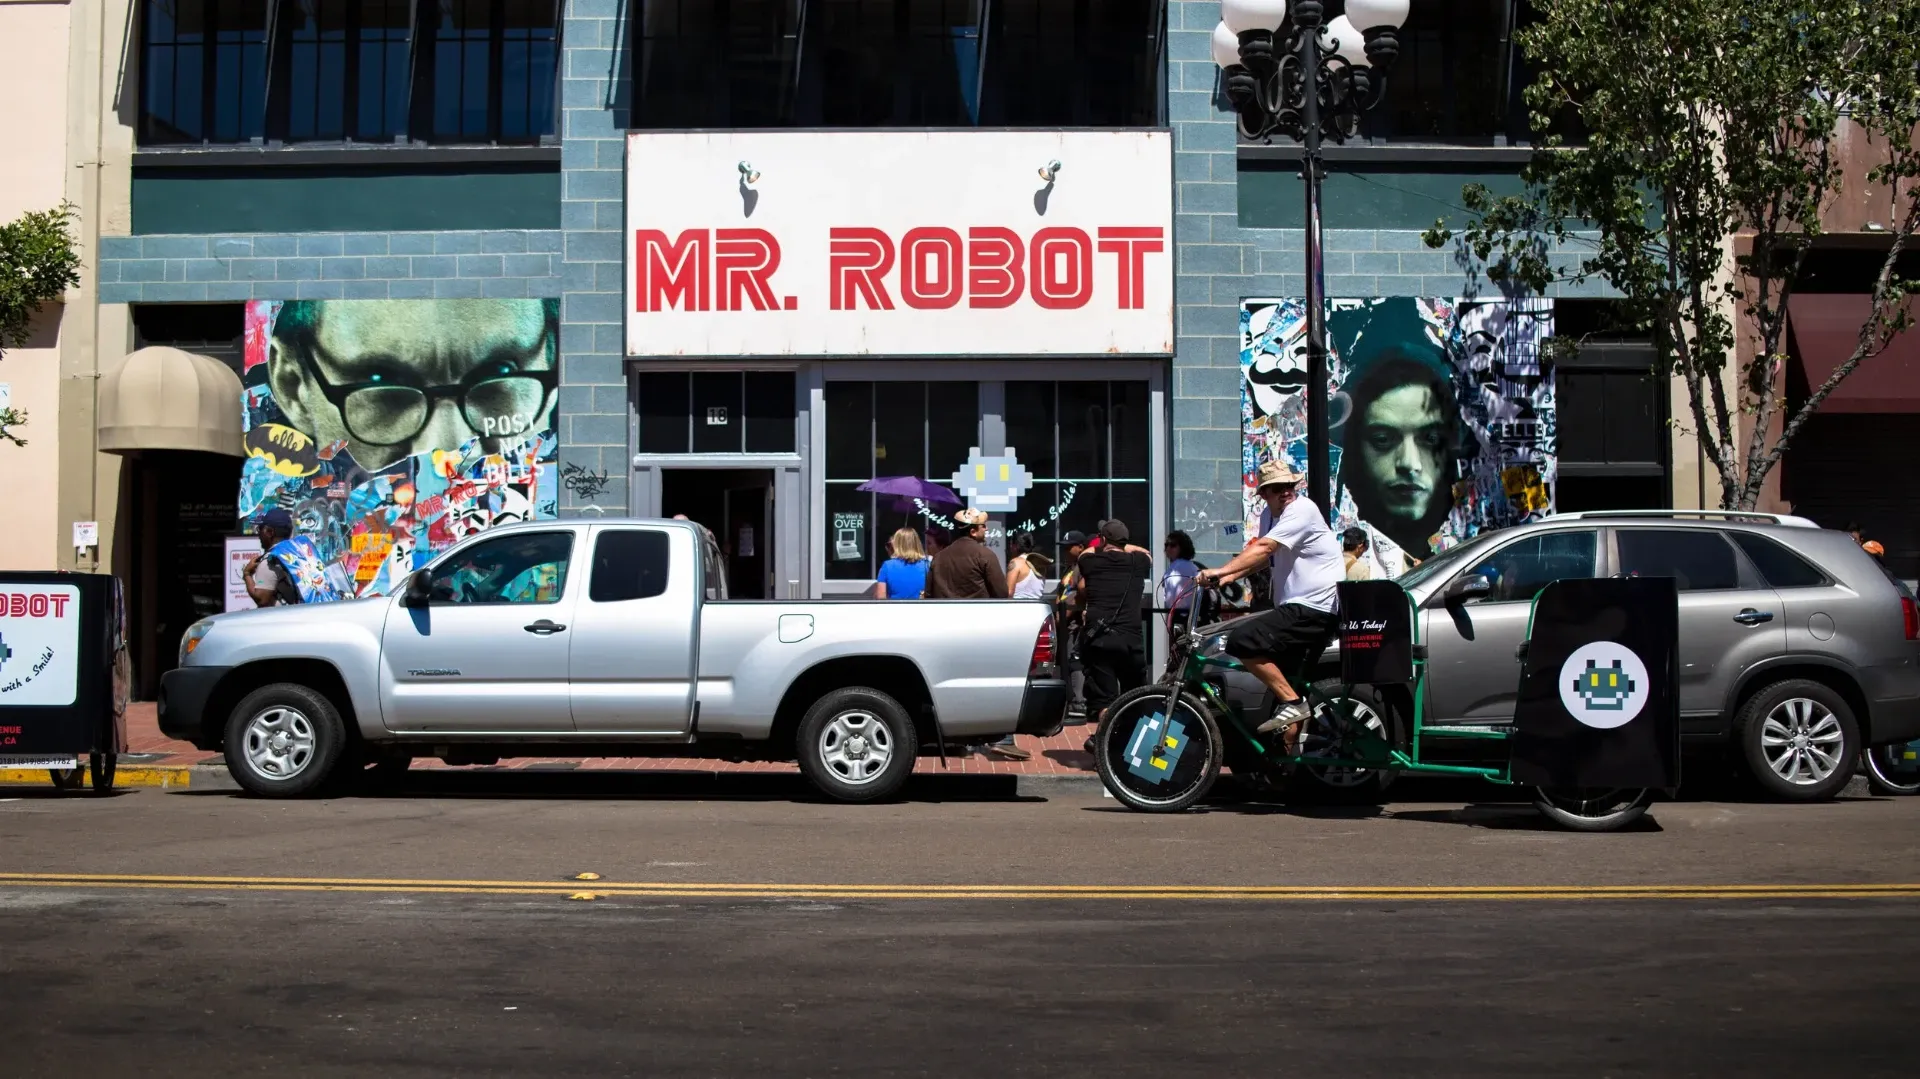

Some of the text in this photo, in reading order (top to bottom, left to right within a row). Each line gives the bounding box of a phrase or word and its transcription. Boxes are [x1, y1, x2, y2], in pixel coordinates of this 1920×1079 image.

[635, 226, 1164, 313] MR. ROBOT
[483, 411, 538, 438] POST
[709, 408, 727, 423] 18
[499, 435, 528, 459] NO
[487, 456, 545, 488] BILLS
[1048, 480, 1078, 520] Smile!
[834, 519, 864, 528] OVER
[1349, 620, 1358, 630] Us
[1361, 620, 1387, 631] Today!
[2, 678, 22, 693] with
[33, 646, 54, 676] Smile!
[407, 668, 461, 676] TACOMA
[4, 737, 17, 745] CA
